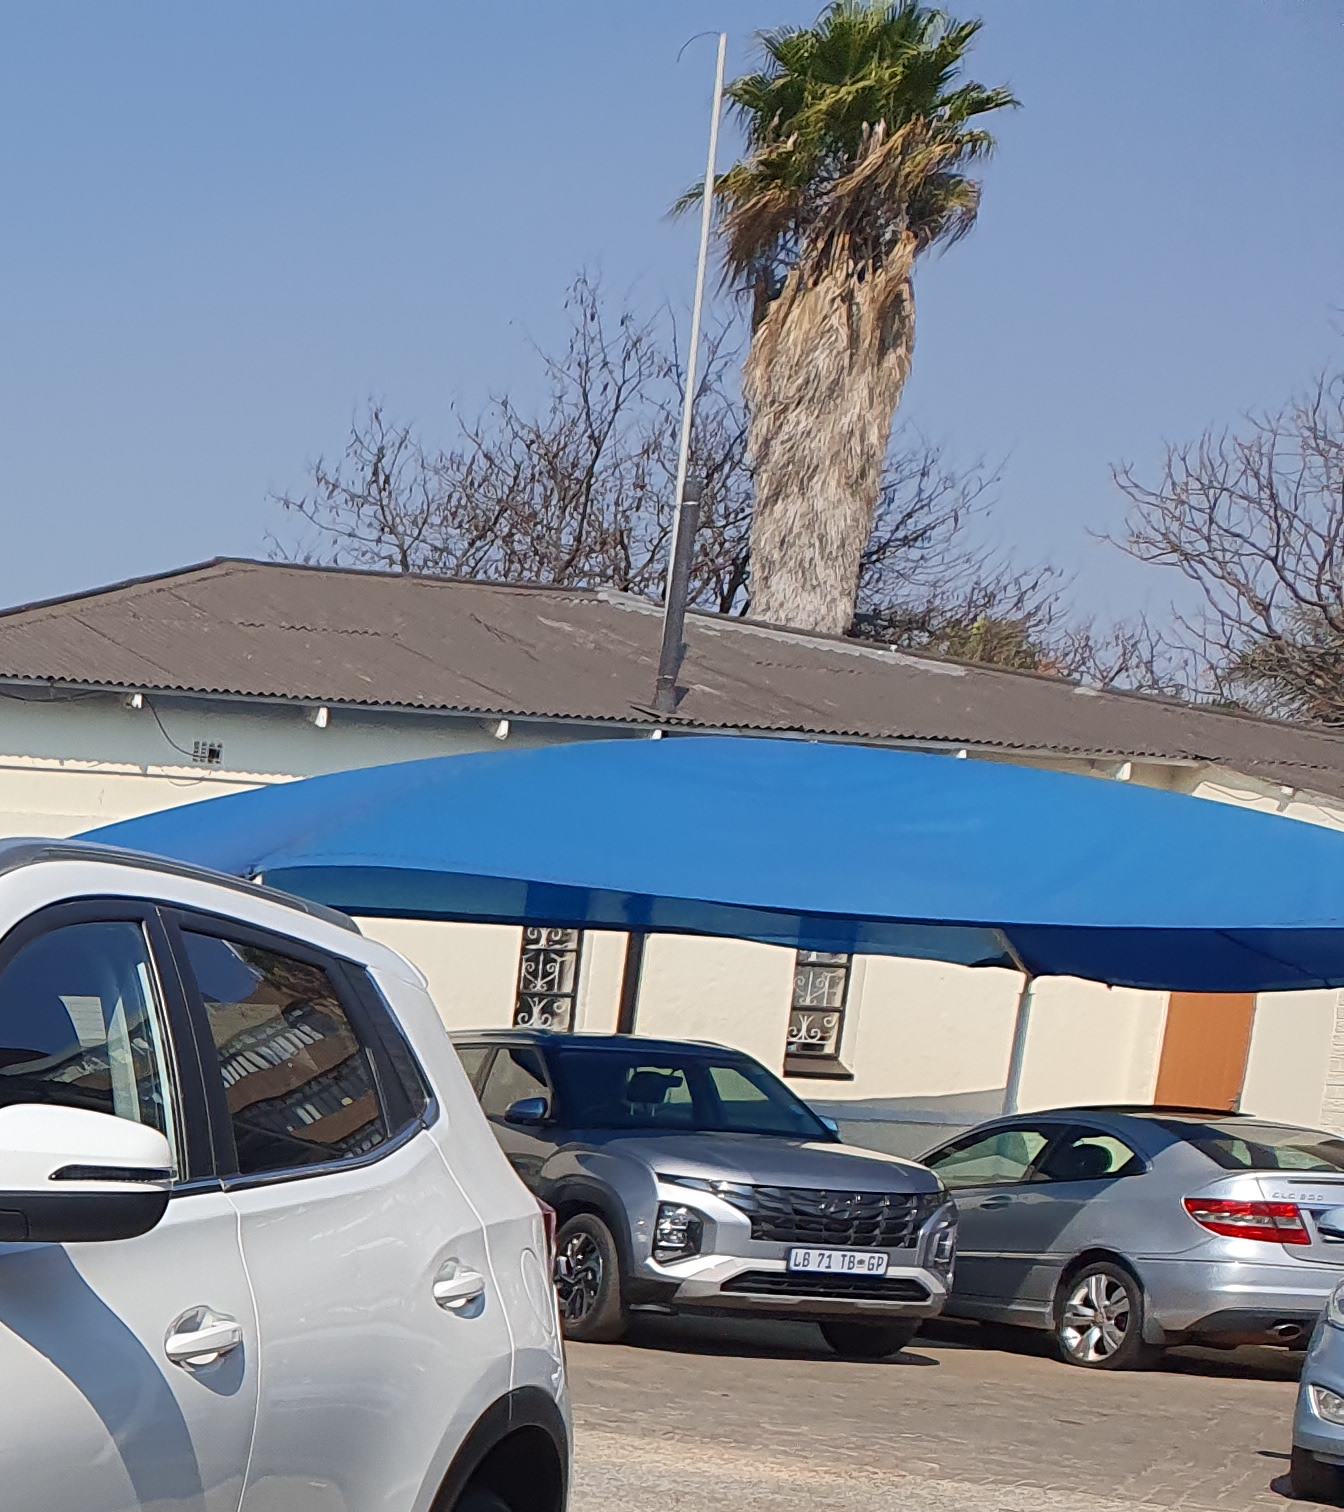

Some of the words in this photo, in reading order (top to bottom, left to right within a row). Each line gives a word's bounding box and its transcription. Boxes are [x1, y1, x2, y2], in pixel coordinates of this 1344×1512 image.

[793, 1251, 811, 1268] LB
[817, 1252, 832, 1269] 71
[840, 1253, 856, 1270] TB
[867, 1255, 885, 1272] GP
